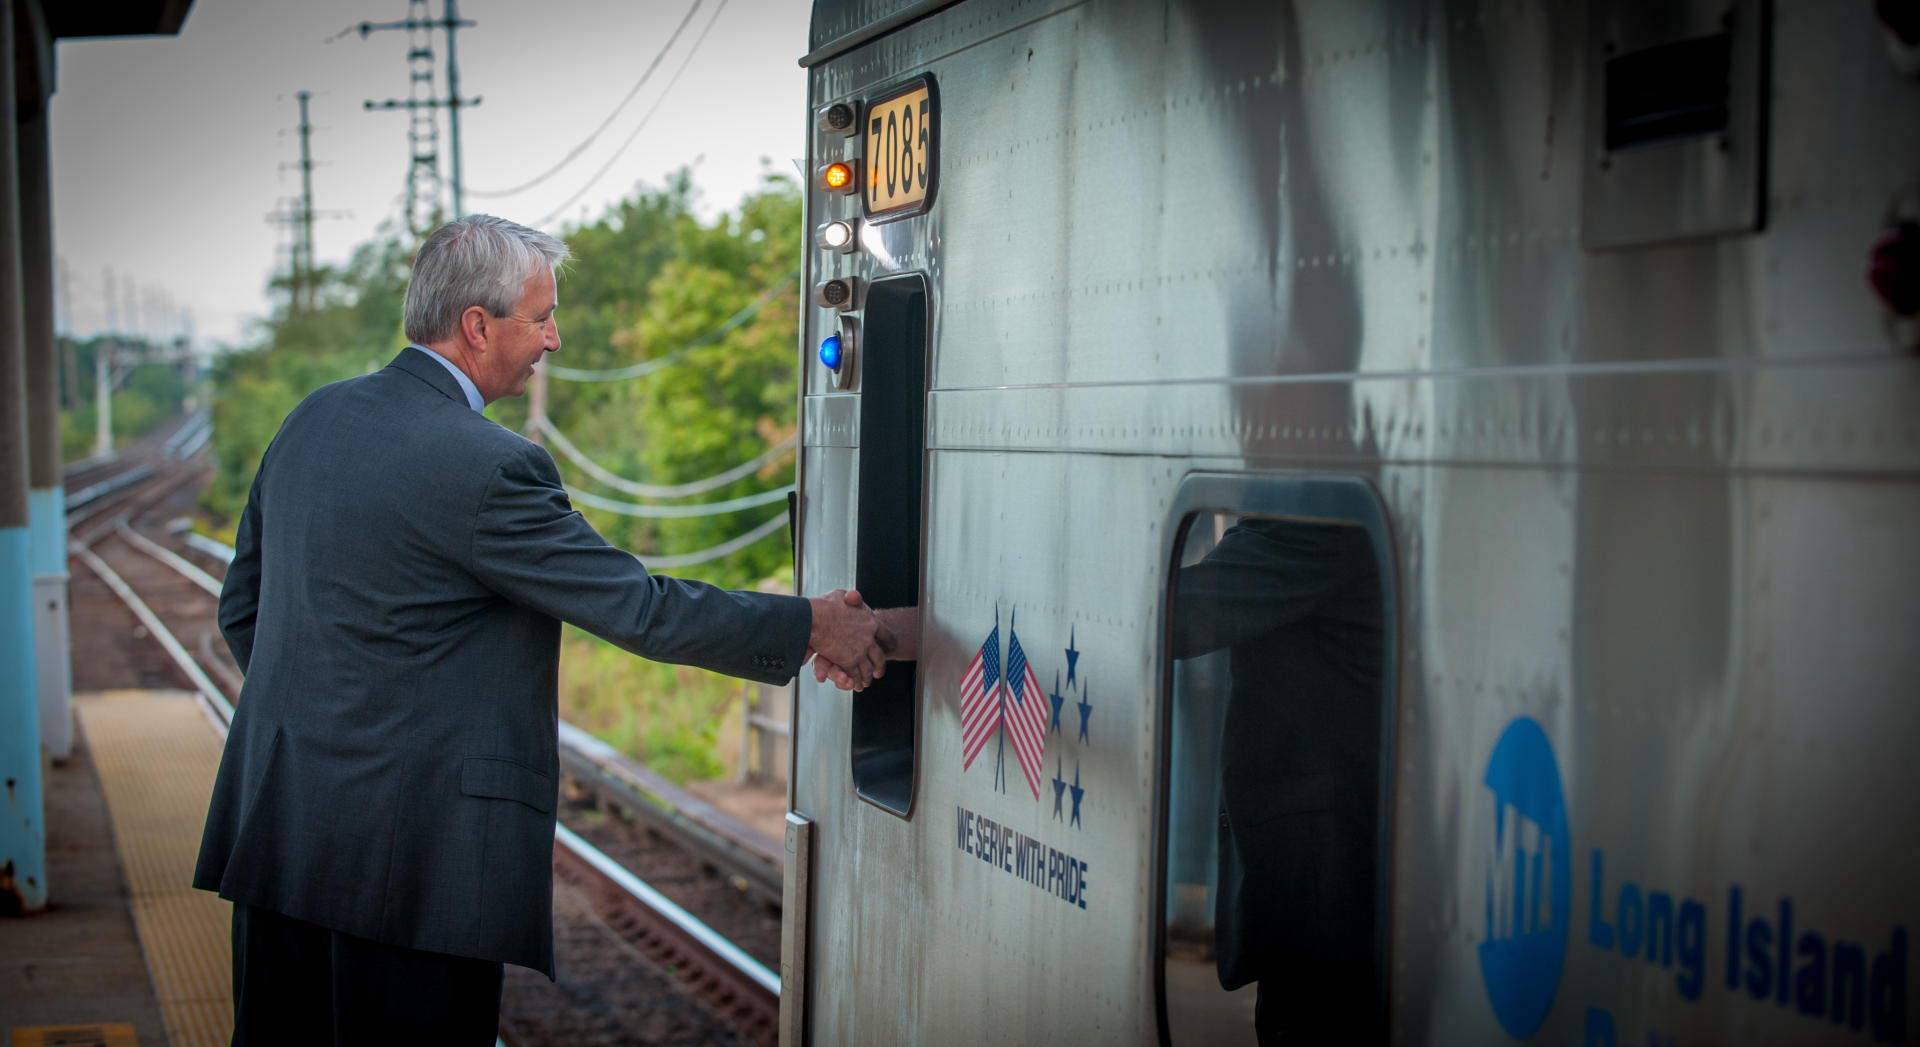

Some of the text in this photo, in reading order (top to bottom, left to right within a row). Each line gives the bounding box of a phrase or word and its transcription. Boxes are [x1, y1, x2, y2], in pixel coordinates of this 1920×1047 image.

[871, 98, 929, 202] 7085
[957, 805, 1088, 910] WE SERVE WITH PRIDE
[1485, 784, 1554, 941] MTA
[1590, 849, 1908, 1044] Long Island
